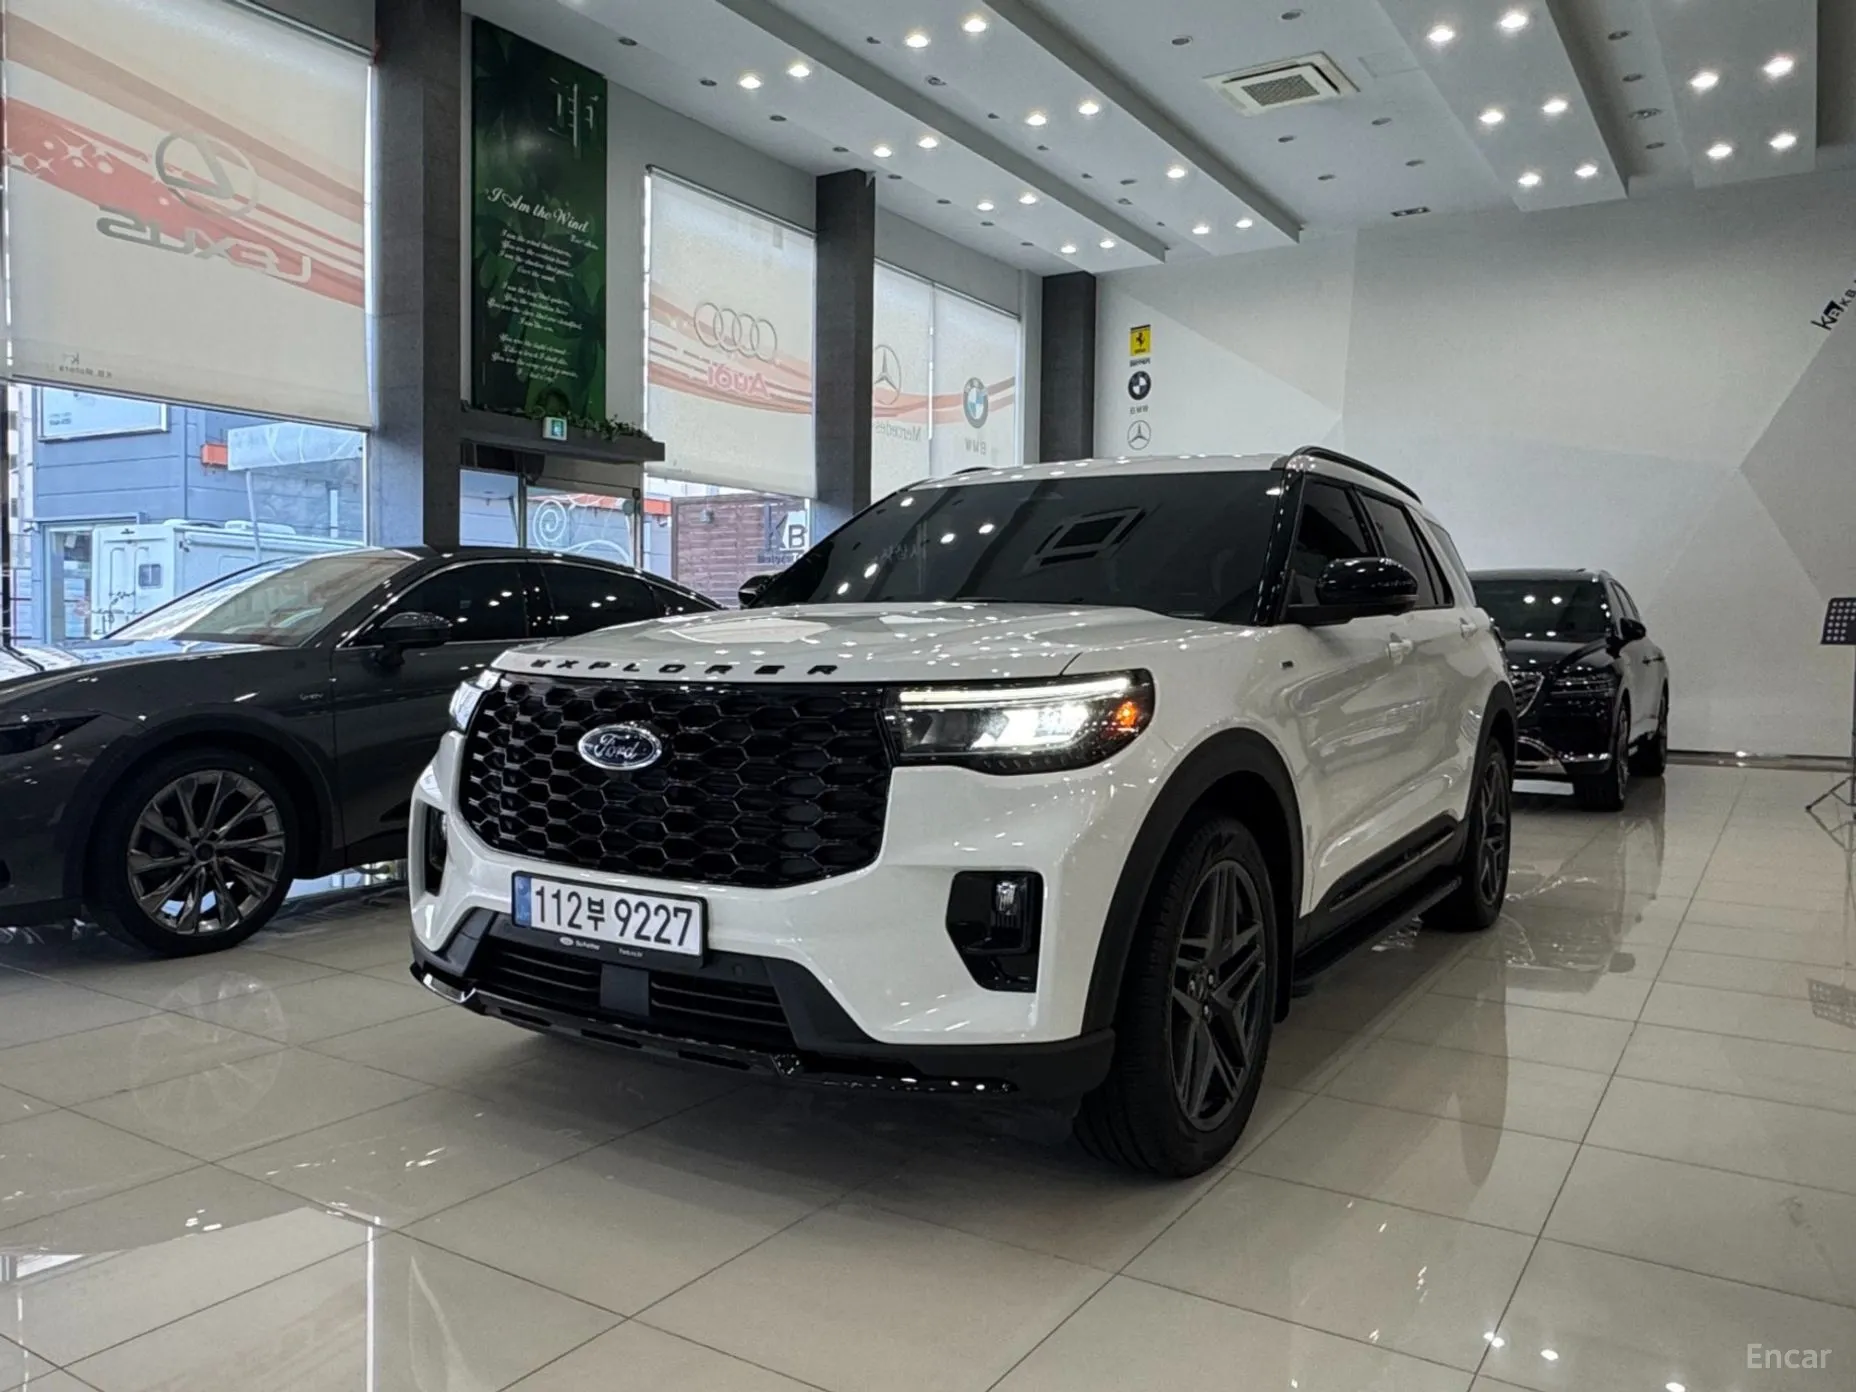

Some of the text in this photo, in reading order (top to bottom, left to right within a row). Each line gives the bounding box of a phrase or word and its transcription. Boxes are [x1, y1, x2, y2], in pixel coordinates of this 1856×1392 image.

[533, 204, 552, 221] the
[553, 208, 589, 233] Wind
[530, 658, 839, 676] EXPLORER
[594, 733, 641, 760] Ford
[535, 886, 692, 946] 112부 9227
